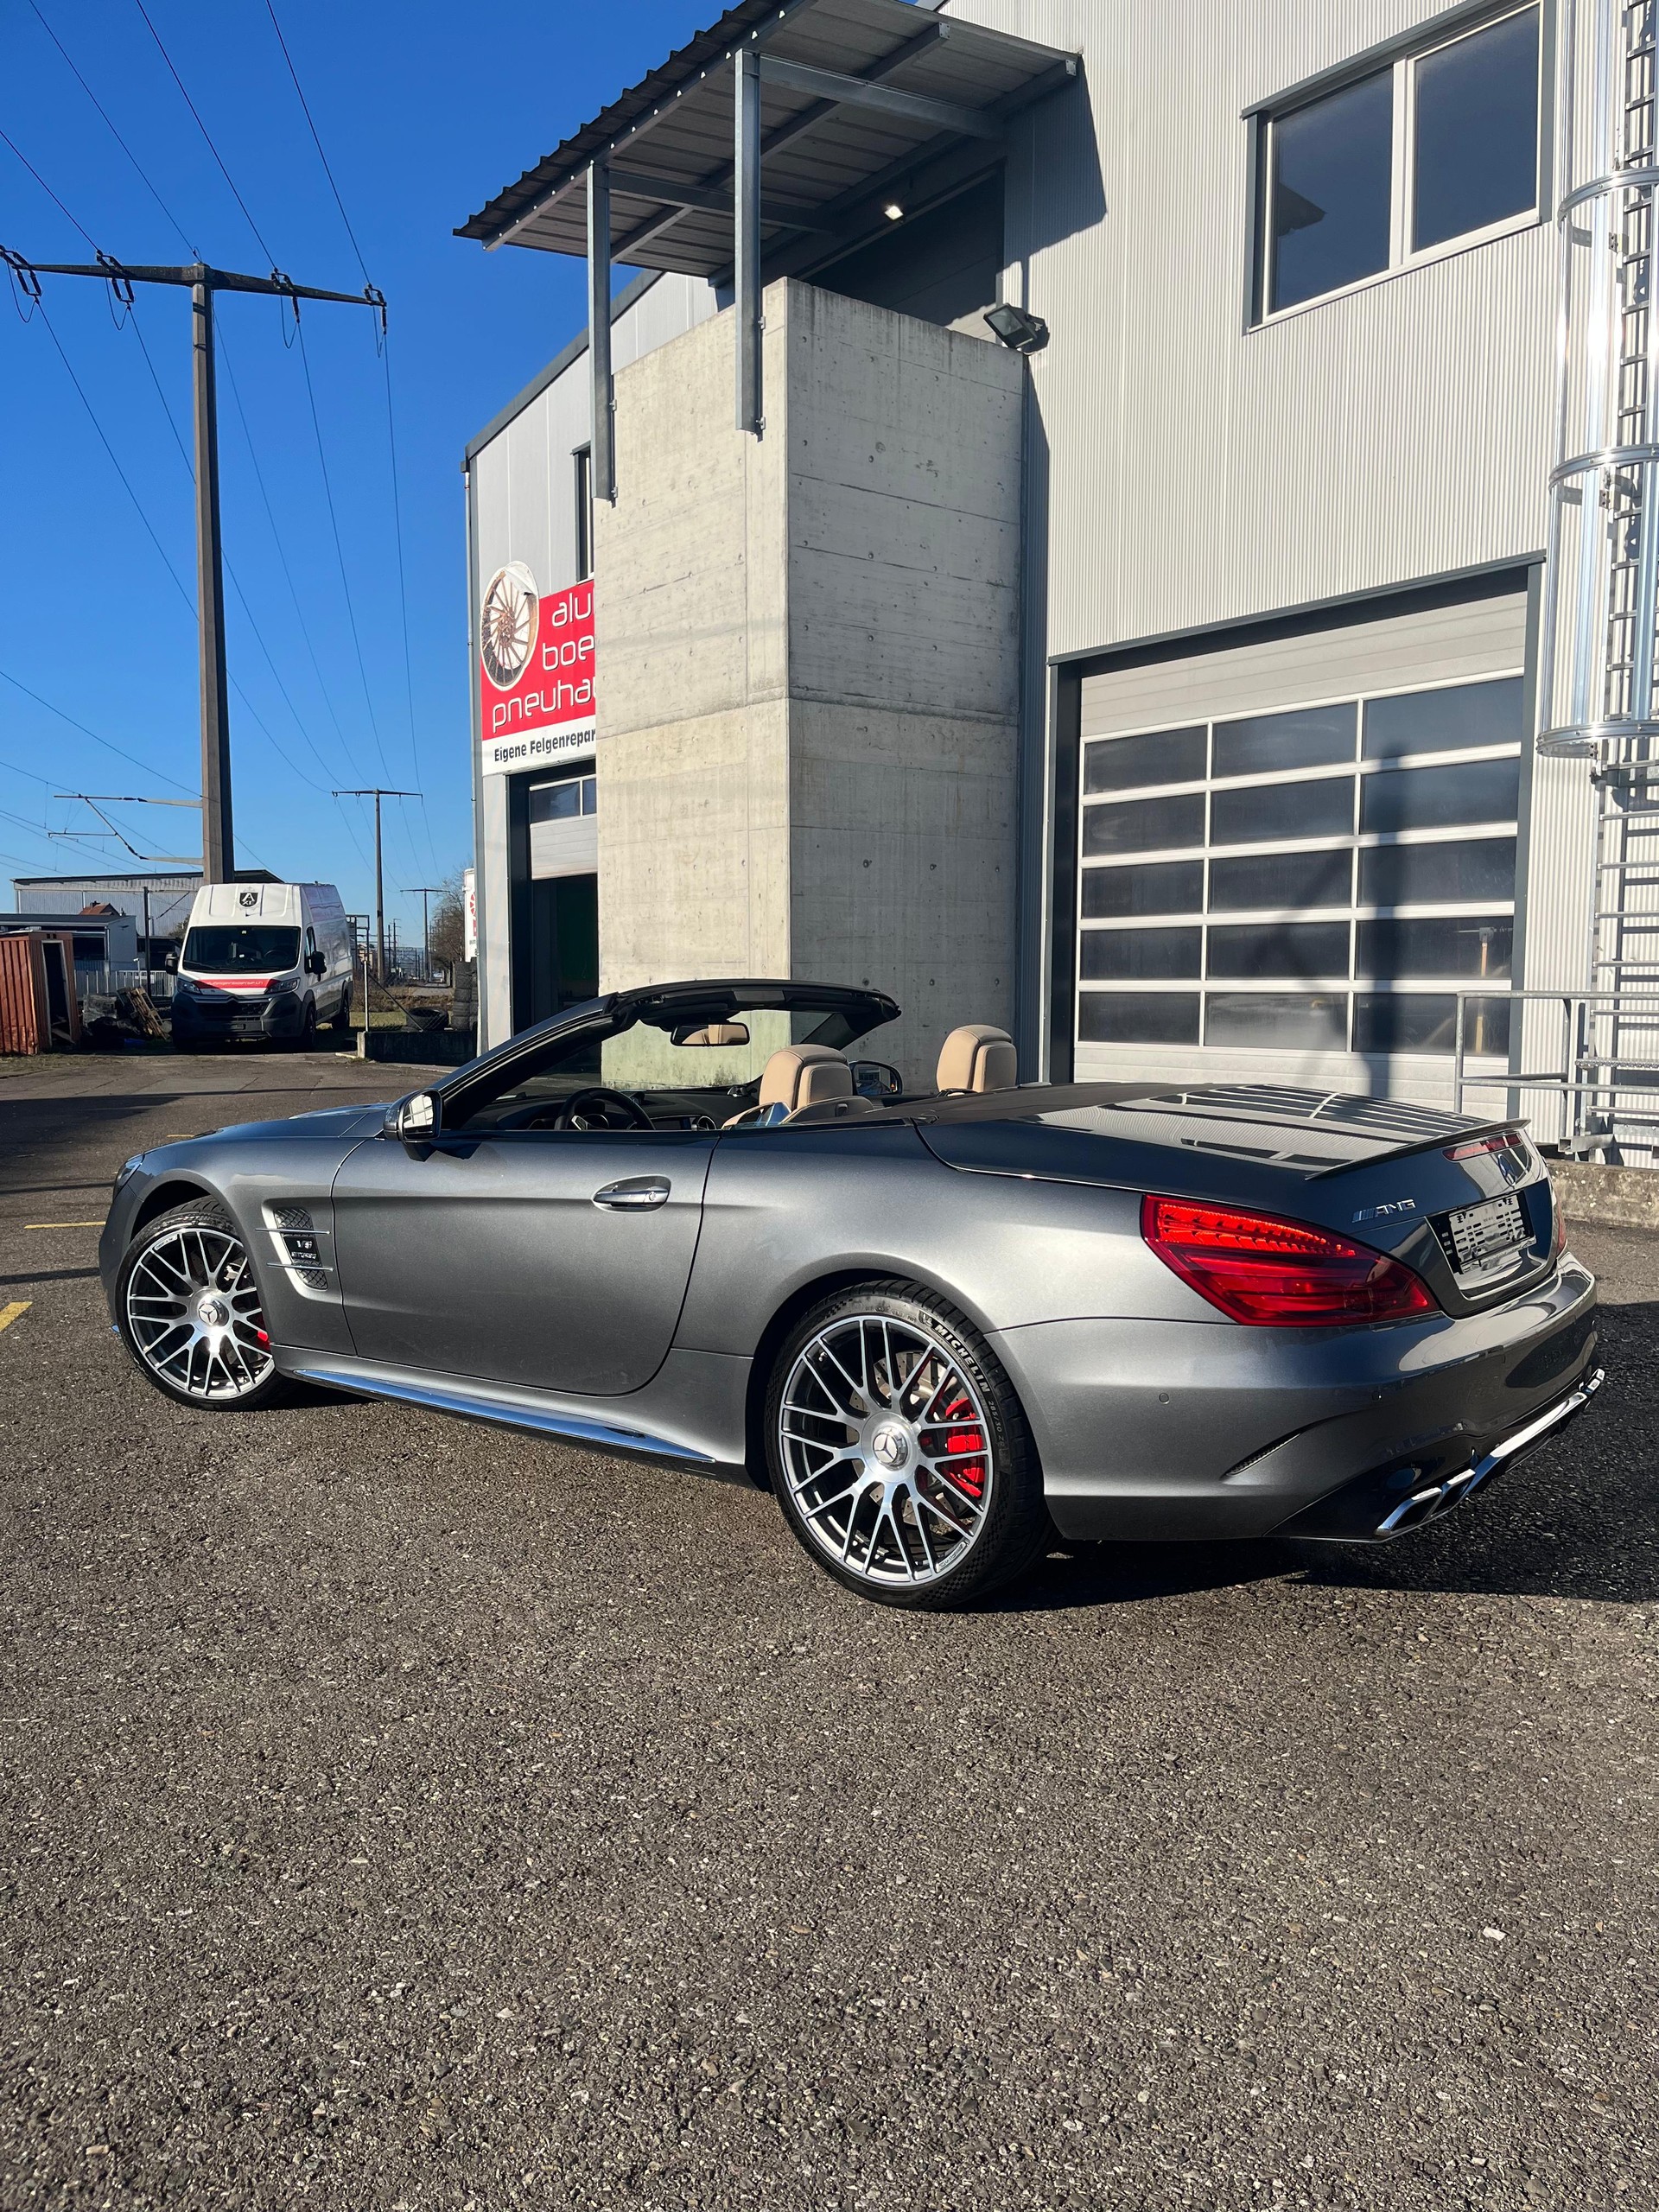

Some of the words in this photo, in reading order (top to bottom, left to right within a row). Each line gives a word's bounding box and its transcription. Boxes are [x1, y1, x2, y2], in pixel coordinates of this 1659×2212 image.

[552, 588, 594, 627] alu
[542, 634, 594, 671] boe
[494, 741, 527, 763] Eigene
[934, 1324, 991, 1393] MICHELIN
[988, 1400, 1002, 1433] 285/30
